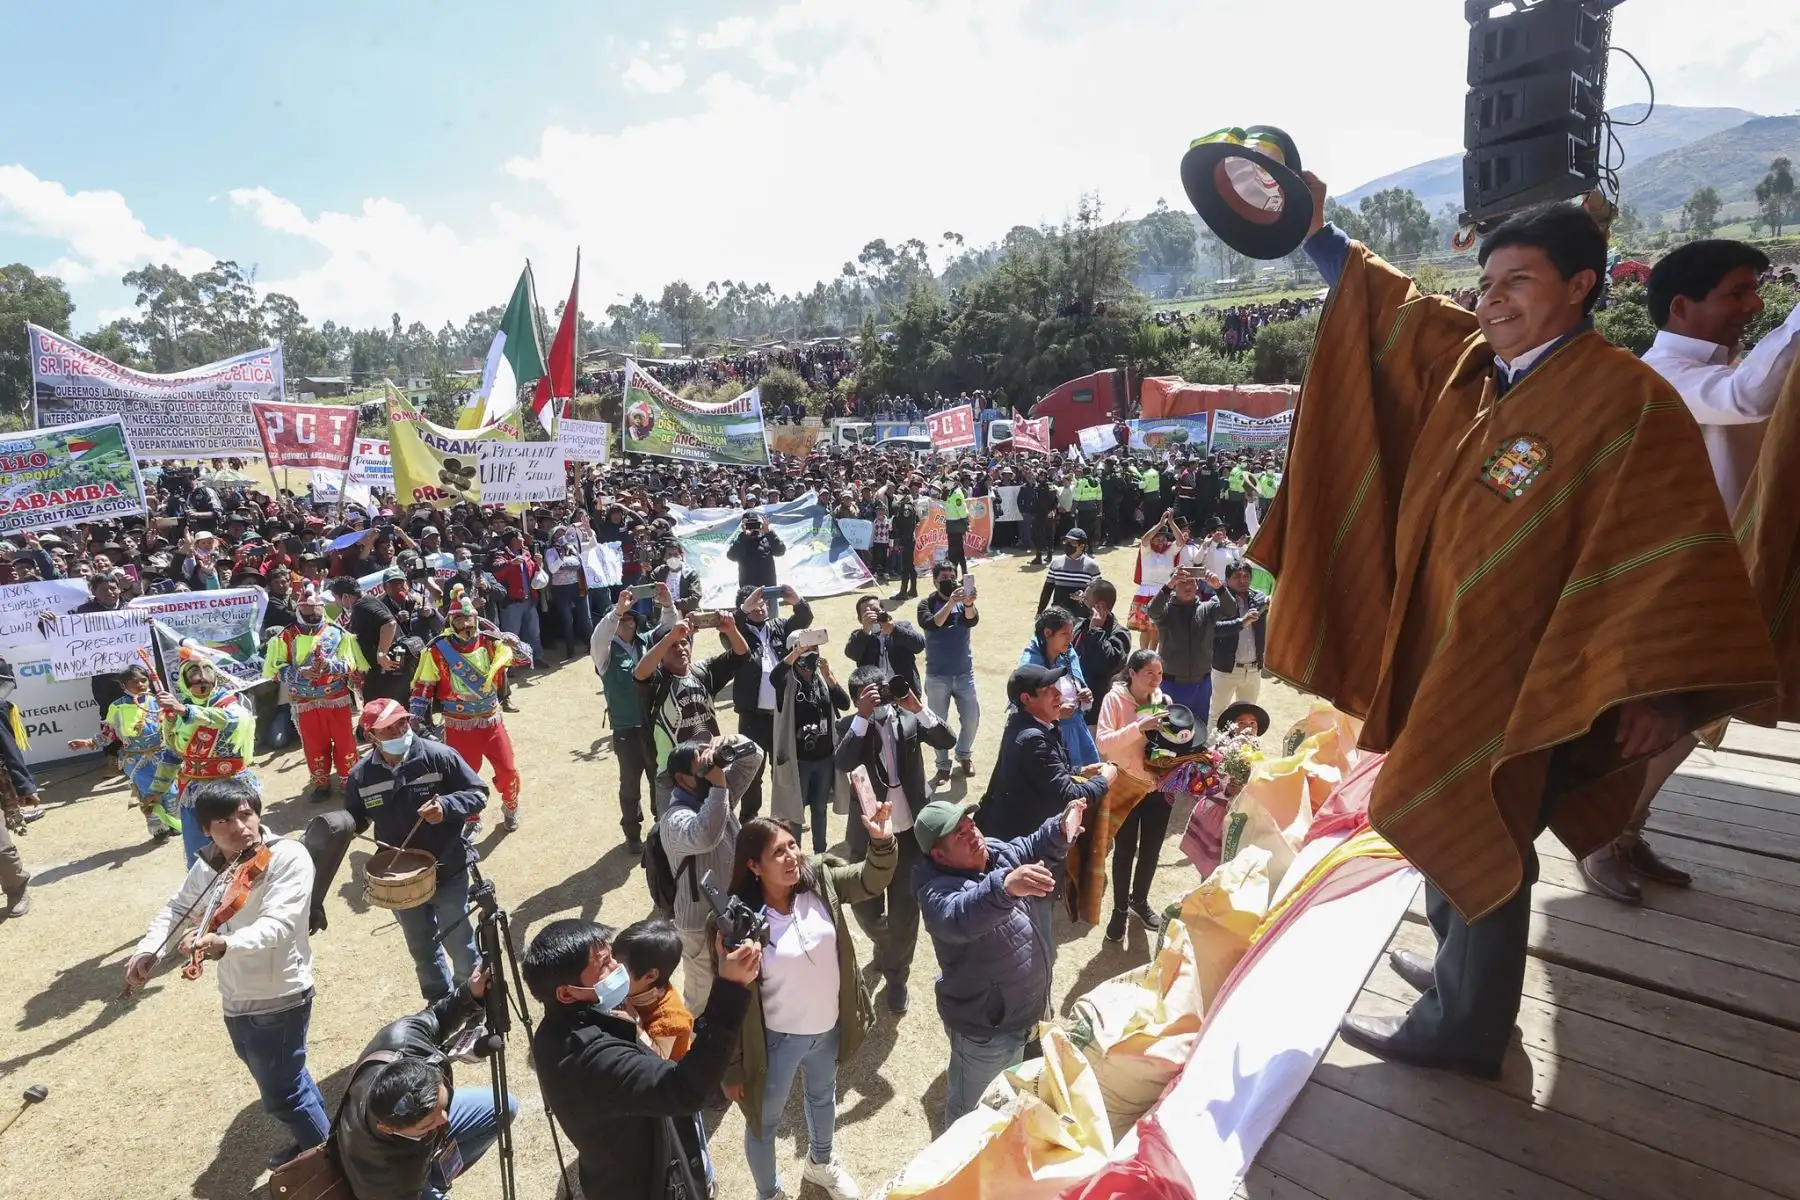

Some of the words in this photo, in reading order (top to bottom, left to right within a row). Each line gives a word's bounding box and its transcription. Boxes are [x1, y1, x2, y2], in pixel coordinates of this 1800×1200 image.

[40, 358, 59, 375] SR.
[56, 386, 99, 398] QUEREMOS
[102, 387, 113, 397] LA
[196, 391, 212, 400] DEL
[215, 391, 259, 400] PROYECTO
[150, 402, 166, 411] LEY
[169, 403, 186, 412] QUE
[189, 403, 228, 412] DECLARA
[230, 403, 241, 412] DE
[44, 412, 77, 424] INTERES
[133, 414, 181, 424] NECESIDAD
[183, 415, 219, 424] PUBLICA
[222, 416, 232, 424] LA
[200, 428, 209, 437] DE
[212, 427, 222, 436] LA
[140, 440, 206, 450] DEPARTAMENTO
[208, 440, 219, 448] DE
[671, 447, 711, 459] APURIMAC
[209, 595, 259, 608] CASTILLO
[165, 616, 200, 628] Pueblo
[66, 633, 137, 656] PRESENTE
[55, 658, 87, 677] MAYOR
